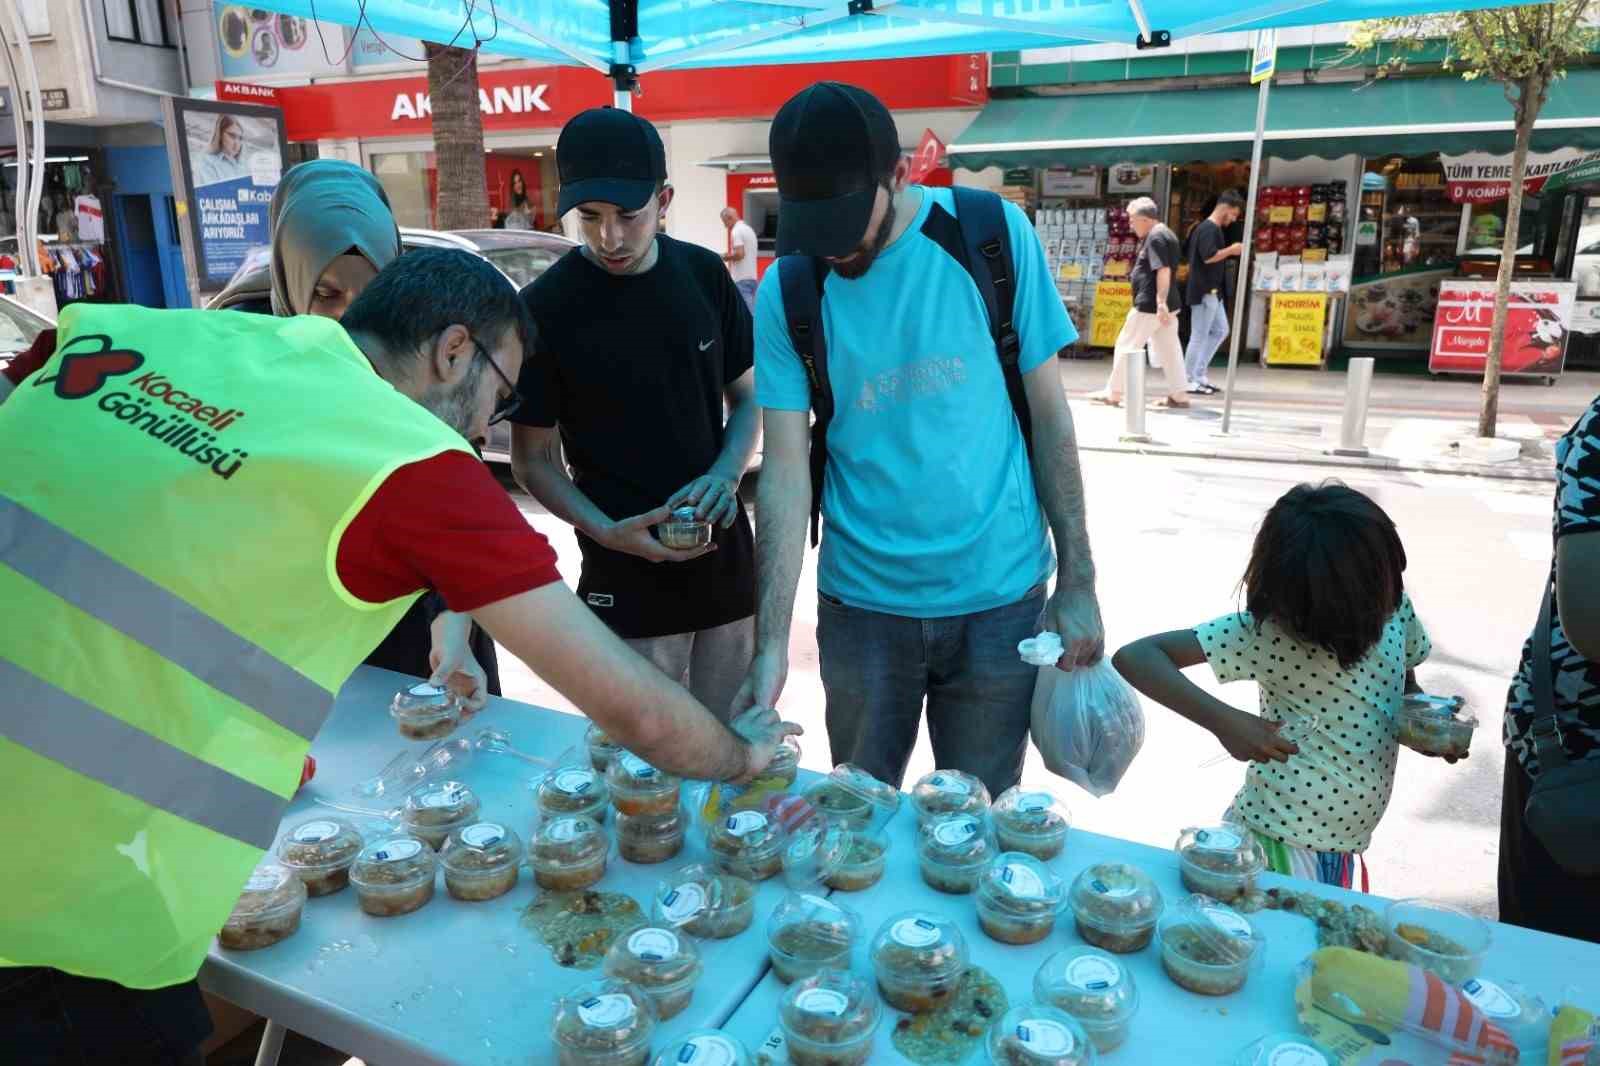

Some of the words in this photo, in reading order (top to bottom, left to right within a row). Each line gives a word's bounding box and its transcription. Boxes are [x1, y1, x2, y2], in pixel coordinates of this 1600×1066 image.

[225, 83, 276, 97] AKBANK
[391, 84, 551, 120] AKANK
[1447, 163, 1473, 178] TÜM
[1477, 165, 1511, 179] YEME
[750, 176, 776, 184] AKBA
[250, 189, 272, 201] Kab
[203, 226, 245, 239] ARIYORUZ
[129, 371, 244, 431] Kocaeli
[98, 392, 248, 480] Gönüllüsü
